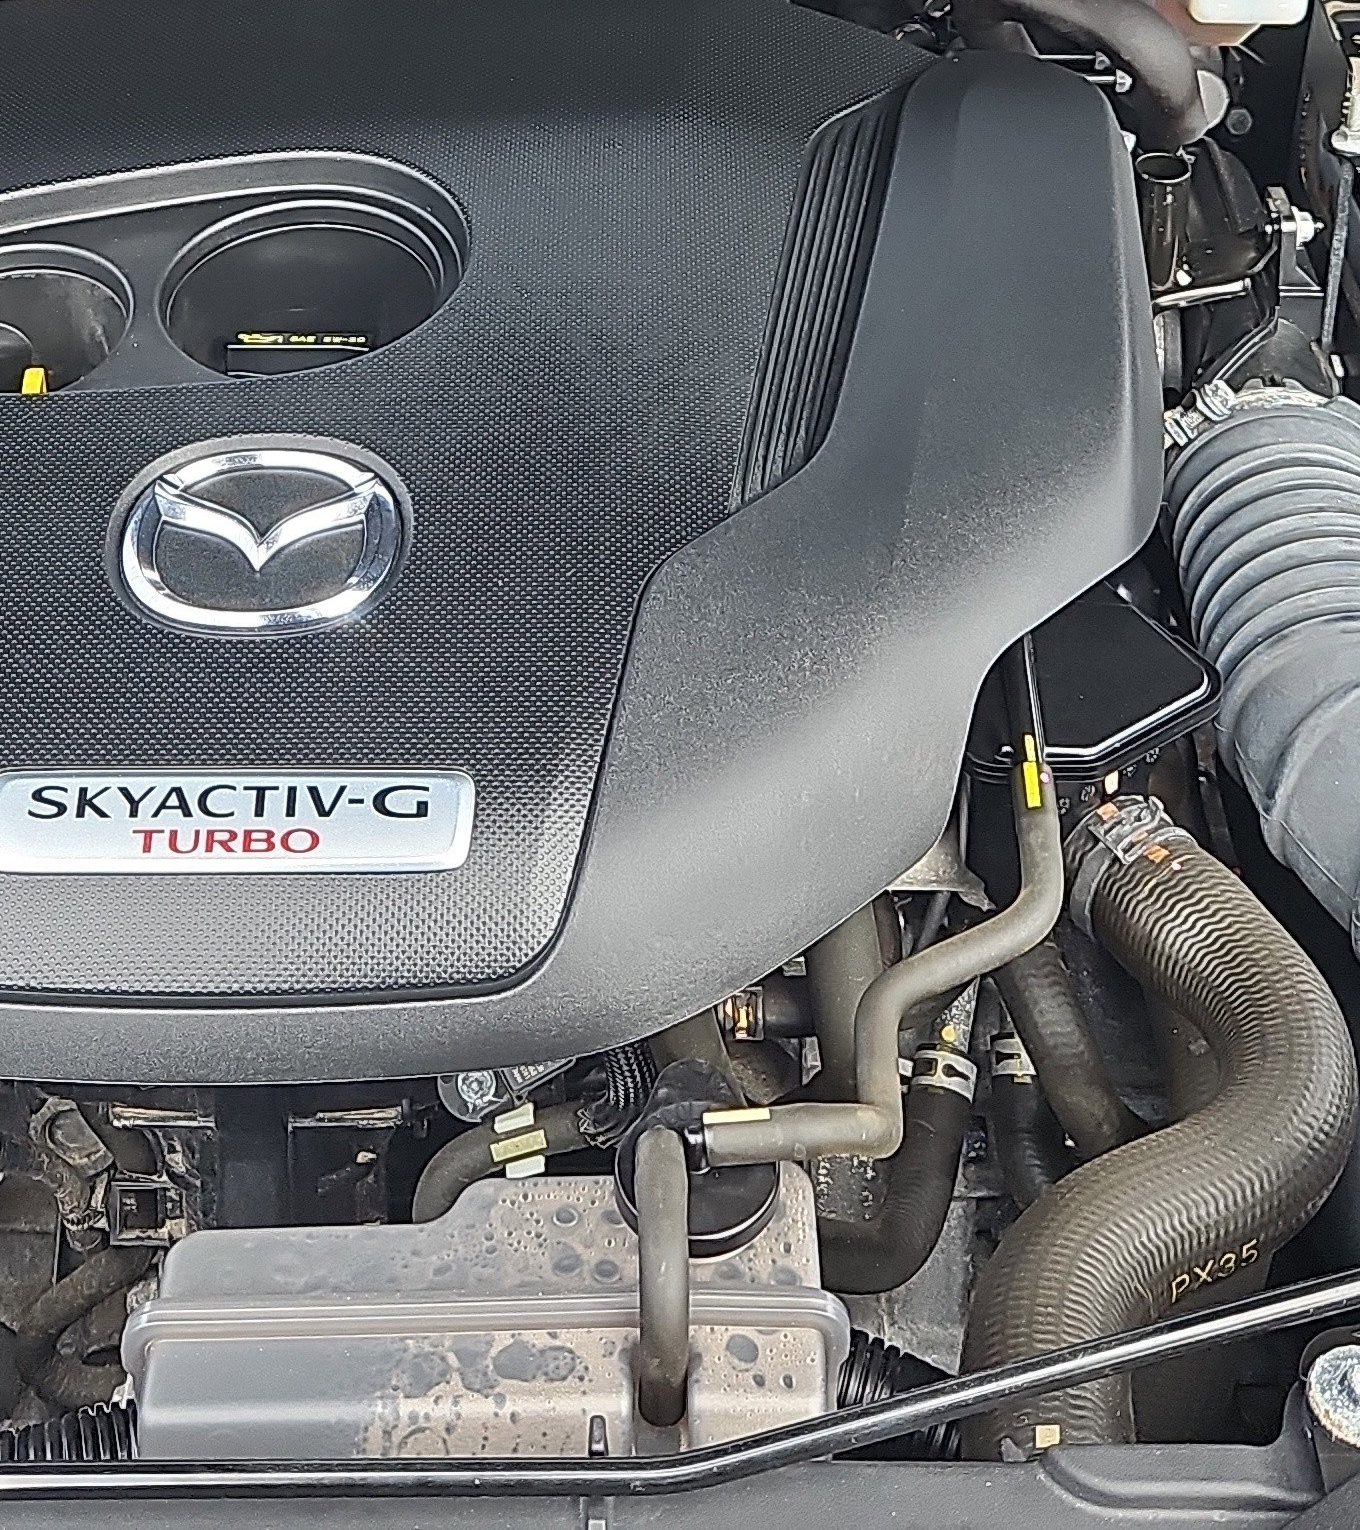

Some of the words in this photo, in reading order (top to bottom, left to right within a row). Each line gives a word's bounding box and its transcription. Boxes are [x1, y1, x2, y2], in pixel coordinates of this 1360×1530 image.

[27, 784, 430, 818] SKYACTIV-G
[132, 828, 320, 854] TURBO
[1171, 1238, 1258, 1304] PX35
